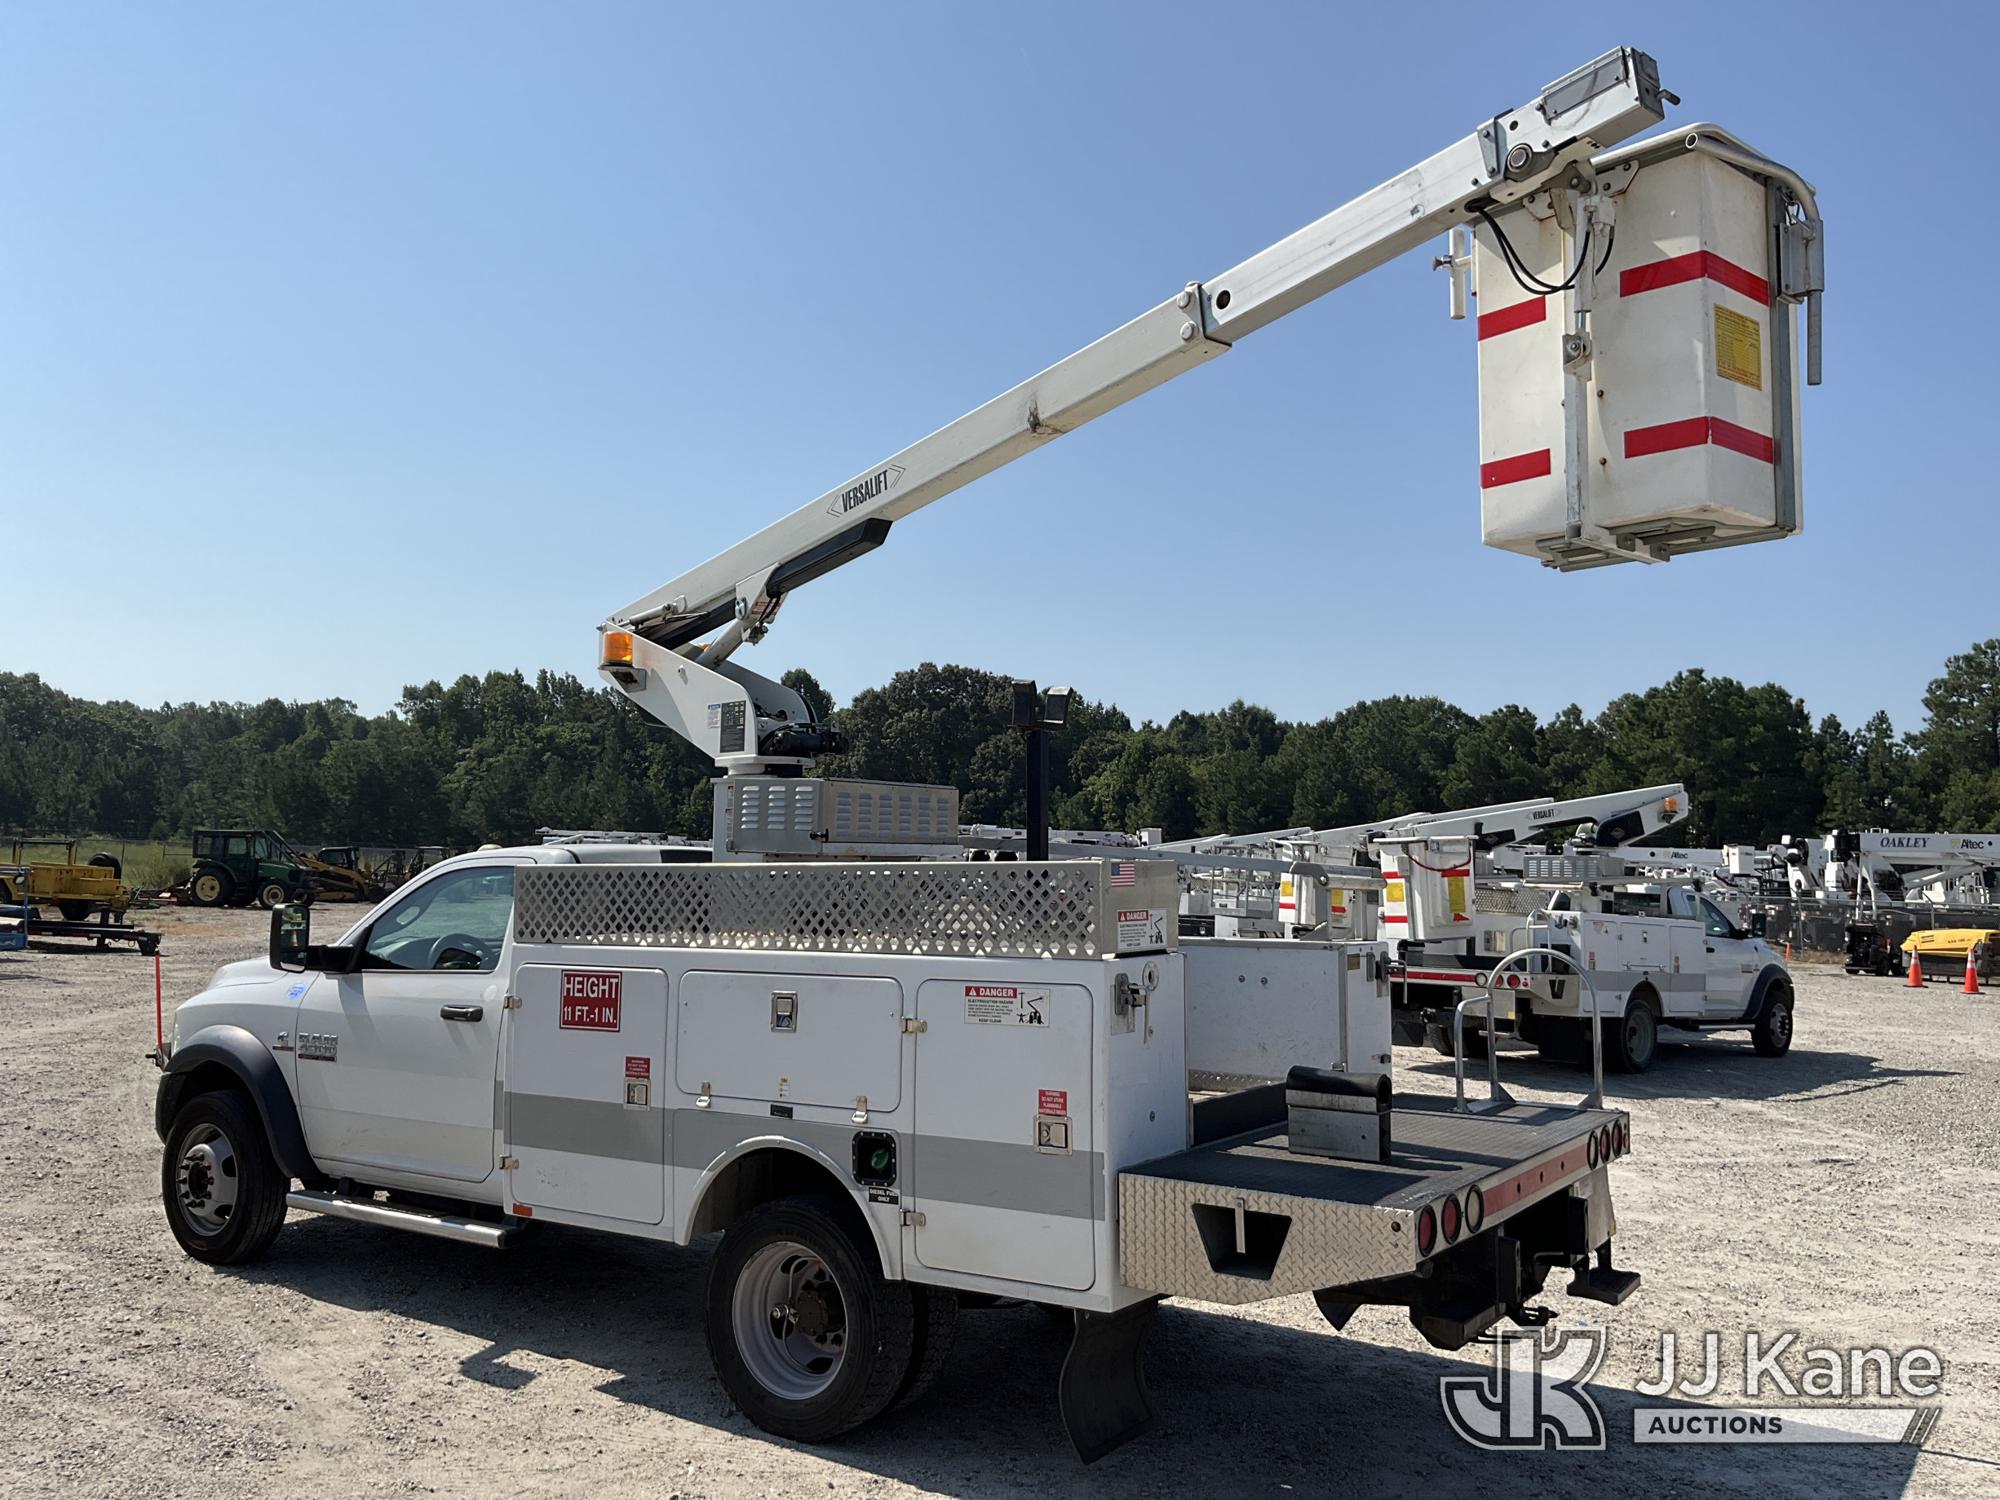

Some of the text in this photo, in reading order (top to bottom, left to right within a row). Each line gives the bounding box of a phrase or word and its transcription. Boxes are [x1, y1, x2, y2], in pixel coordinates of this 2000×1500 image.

[841, 469, 888, 513] VERSALIFT
[1532, 809, 1556, 820] VERSALIFT
[1880, 837, 1930, 848] OAKLEY
[1960, 838, 1985, 850] Altec
[1670, 851, 1689, 859] Altec
[1126, 911, 1147, 920] DANGER
[564, 976, 619, 998] HEIGHT
[979, 987, 1014, 997] DANGER
[564, 1006, 572, 1021] 11
[602, 1007, 617, 1023] IN.
[869, 1188, 885, 1196] DIESEL
